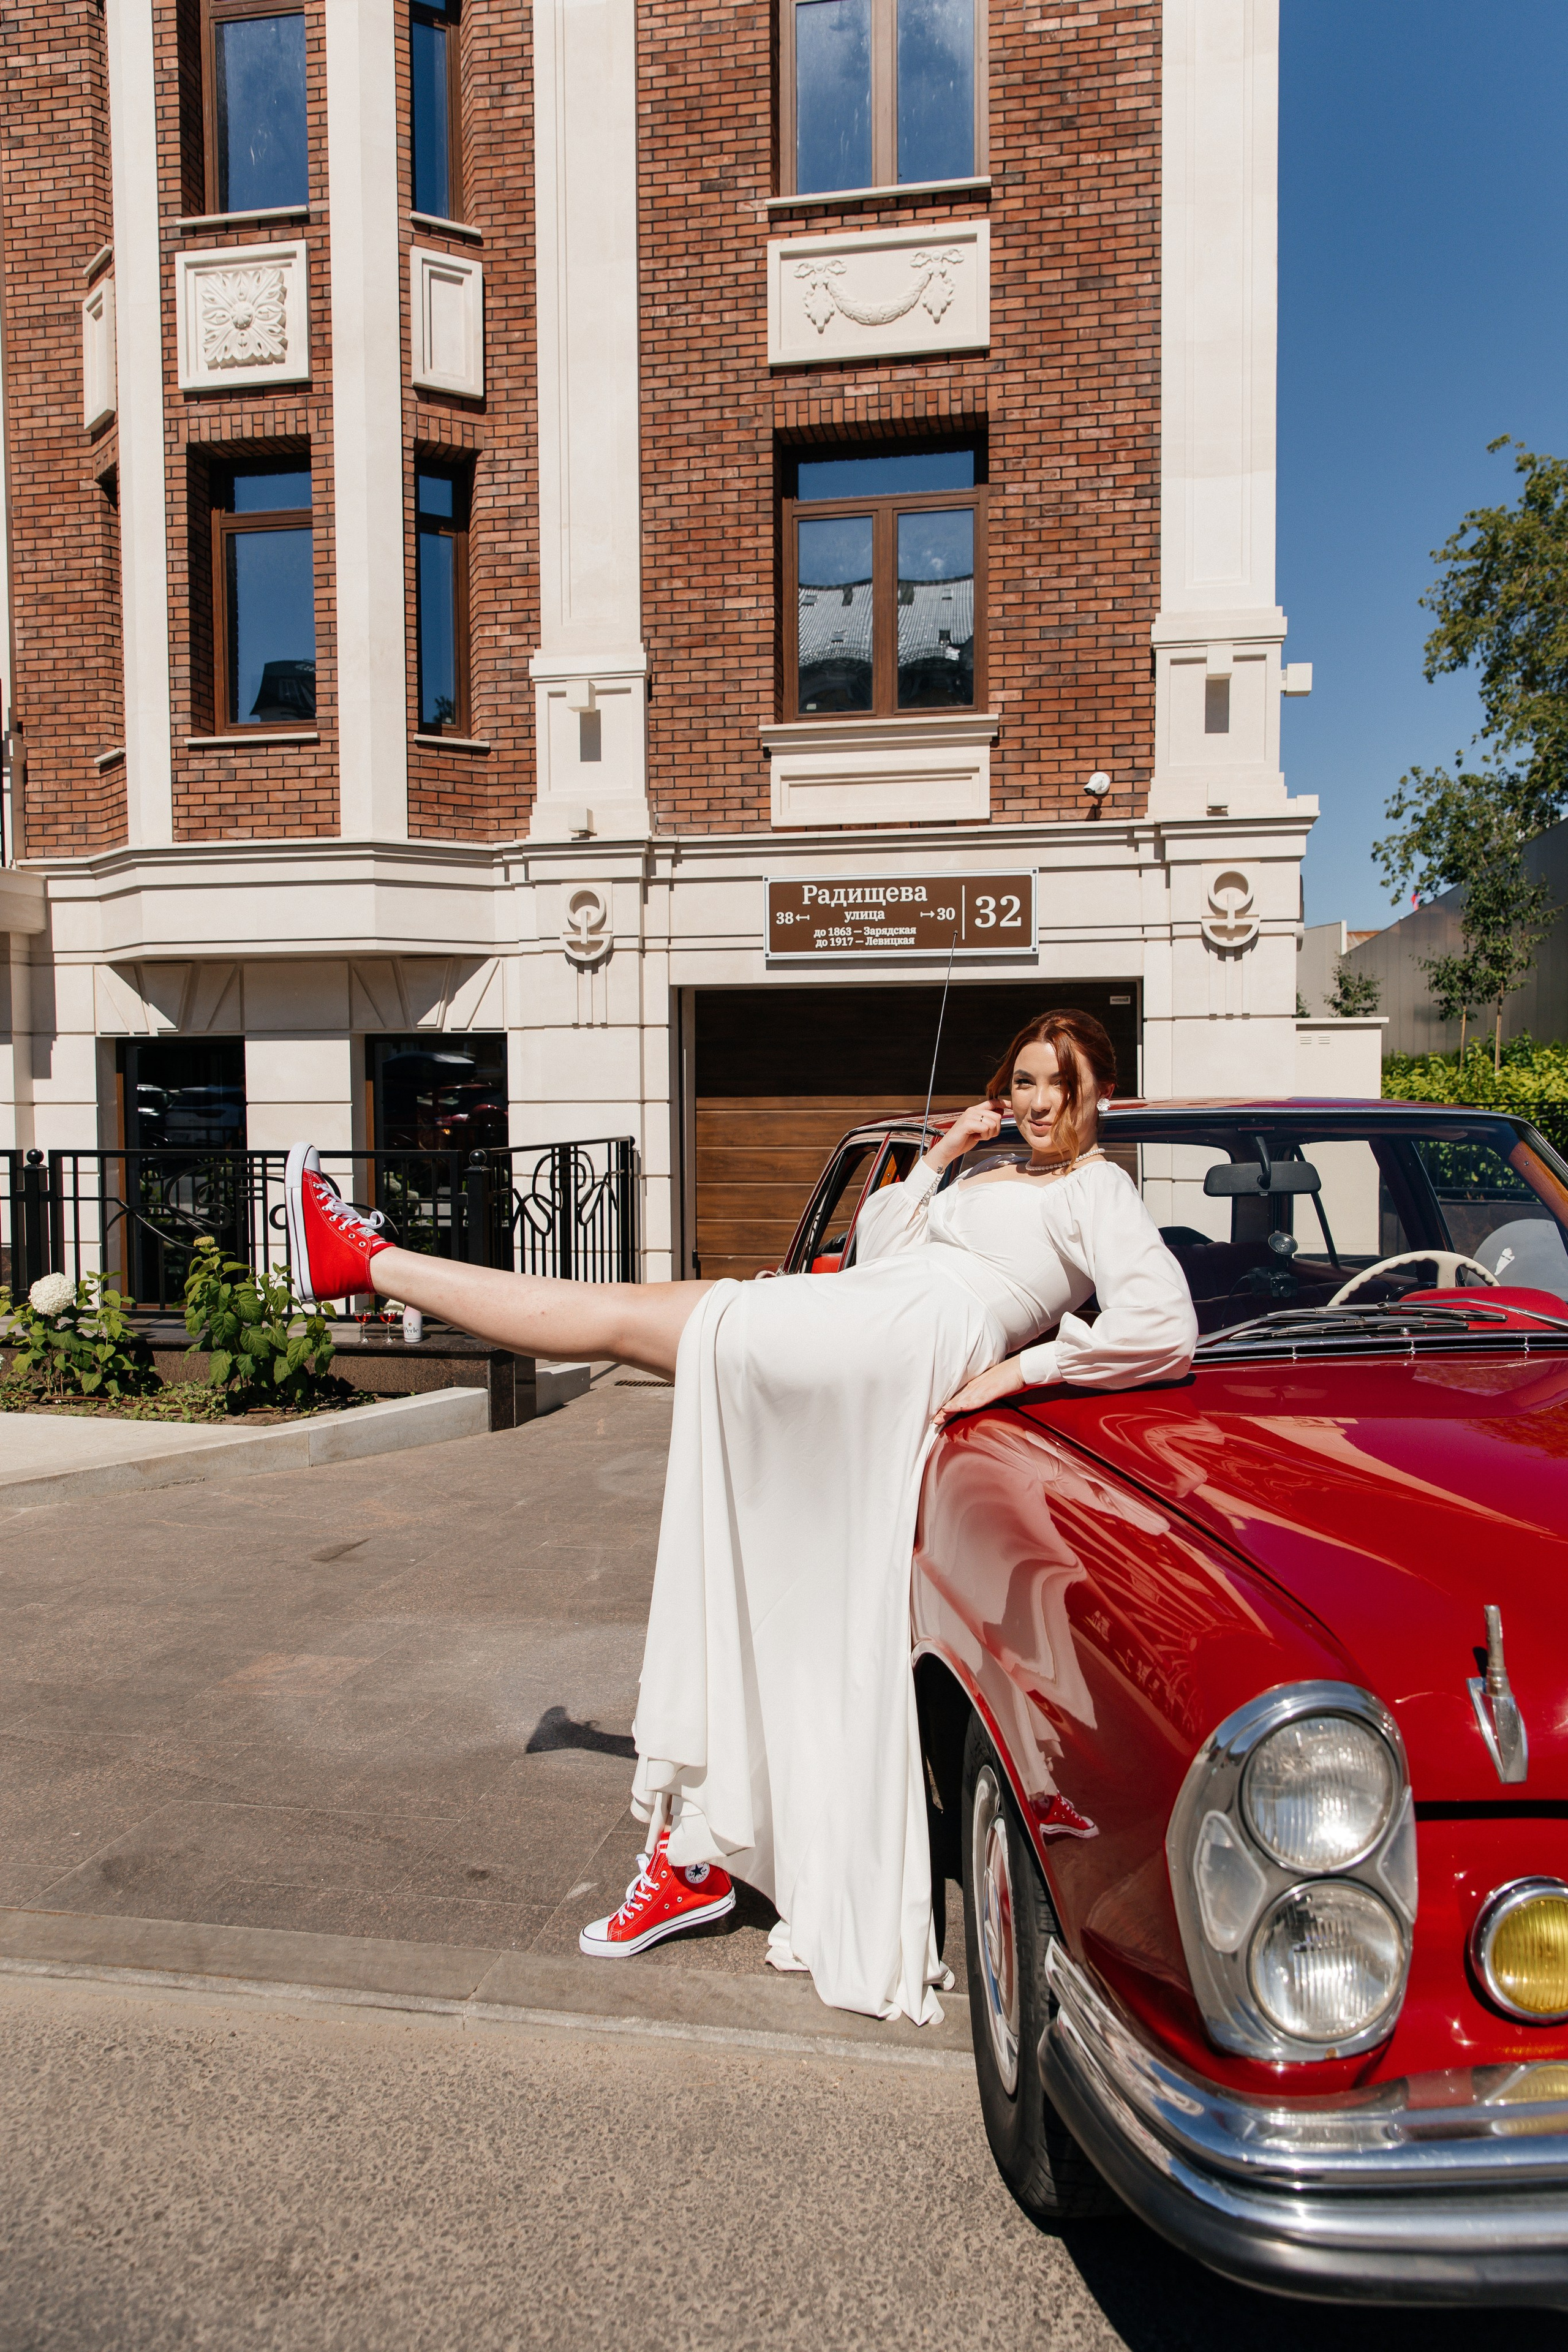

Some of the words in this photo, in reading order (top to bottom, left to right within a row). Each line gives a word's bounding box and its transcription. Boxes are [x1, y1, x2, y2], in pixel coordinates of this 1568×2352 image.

[802, 884, 928, 907] Радищева
[775, 911, 794, 925] 38
[844, 910, 886, 923] улица
[937, 907, 956, 921] 30
[974, 895, 1022, 928] 32
[813, 929, 827, 938] до
[828, 927, 852, 937] 1863
[864, 925, 917, 937] Зарядская
[815, 939, 828, 948] до
[830, 937, 854, 946] 1917
[865, 936, 915, 947] Левицкая
